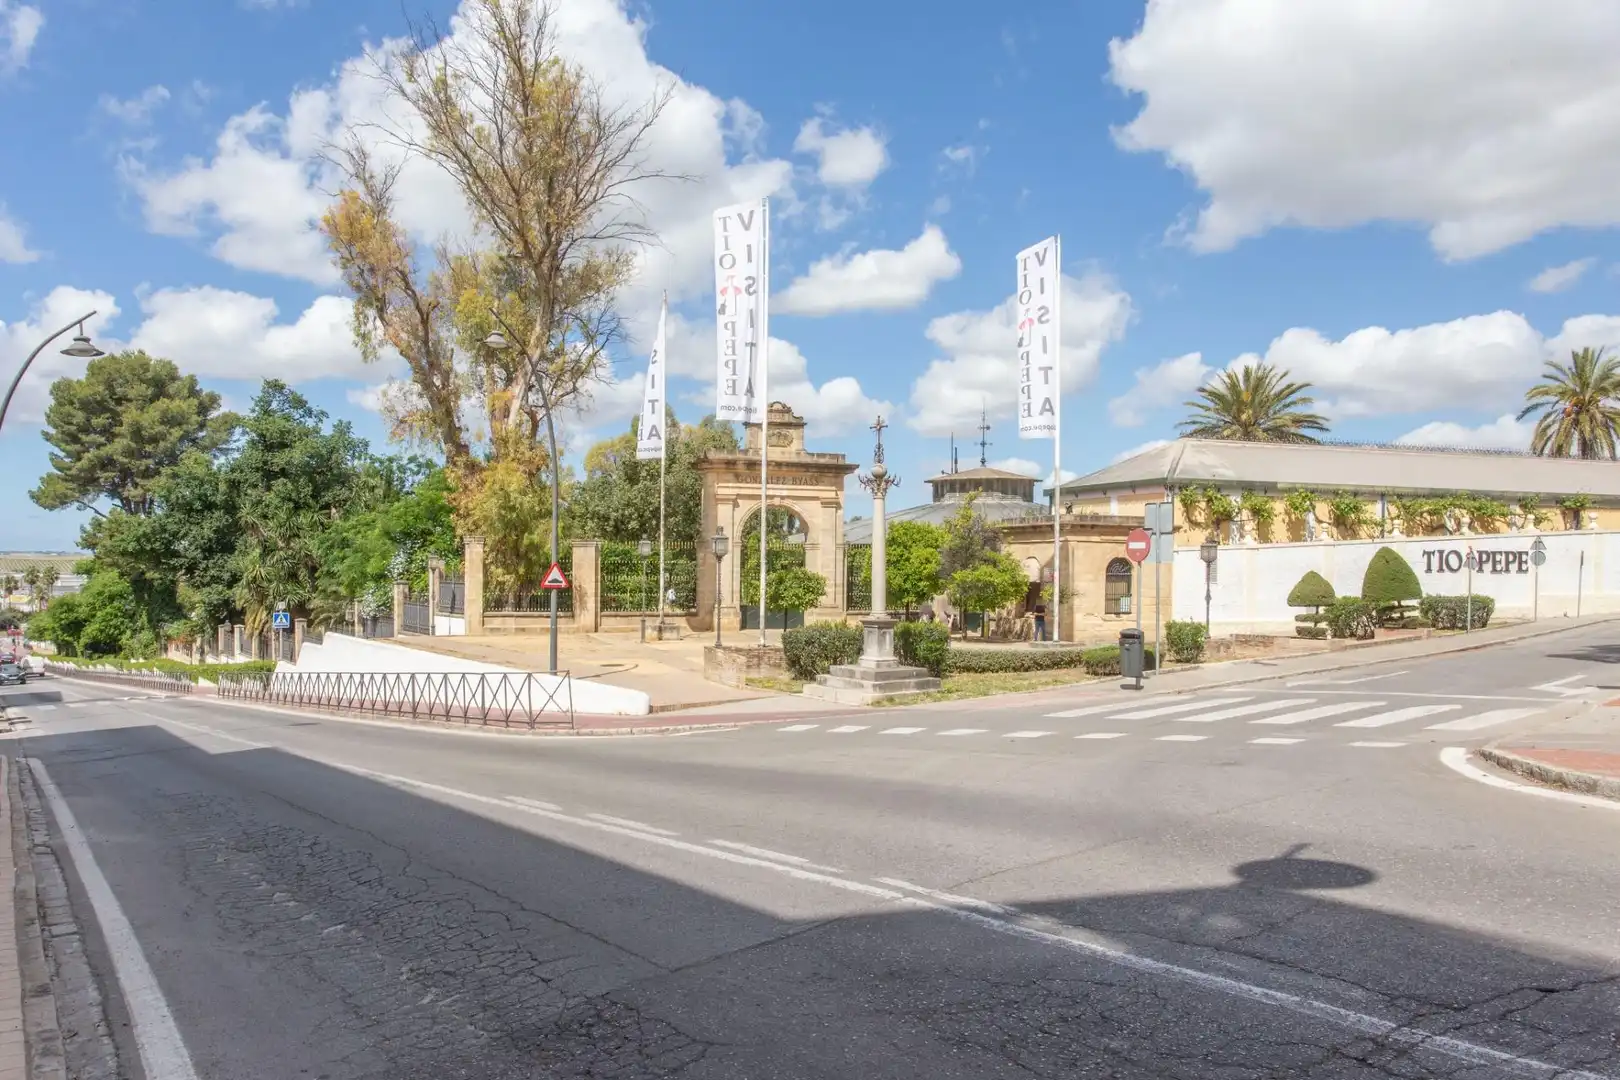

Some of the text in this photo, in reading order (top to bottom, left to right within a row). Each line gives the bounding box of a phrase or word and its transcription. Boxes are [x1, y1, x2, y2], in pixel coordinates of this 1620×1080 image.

[791, 475, 820, 486] BYASS
[1422, 550, 1529, 574] TIO PEPE
